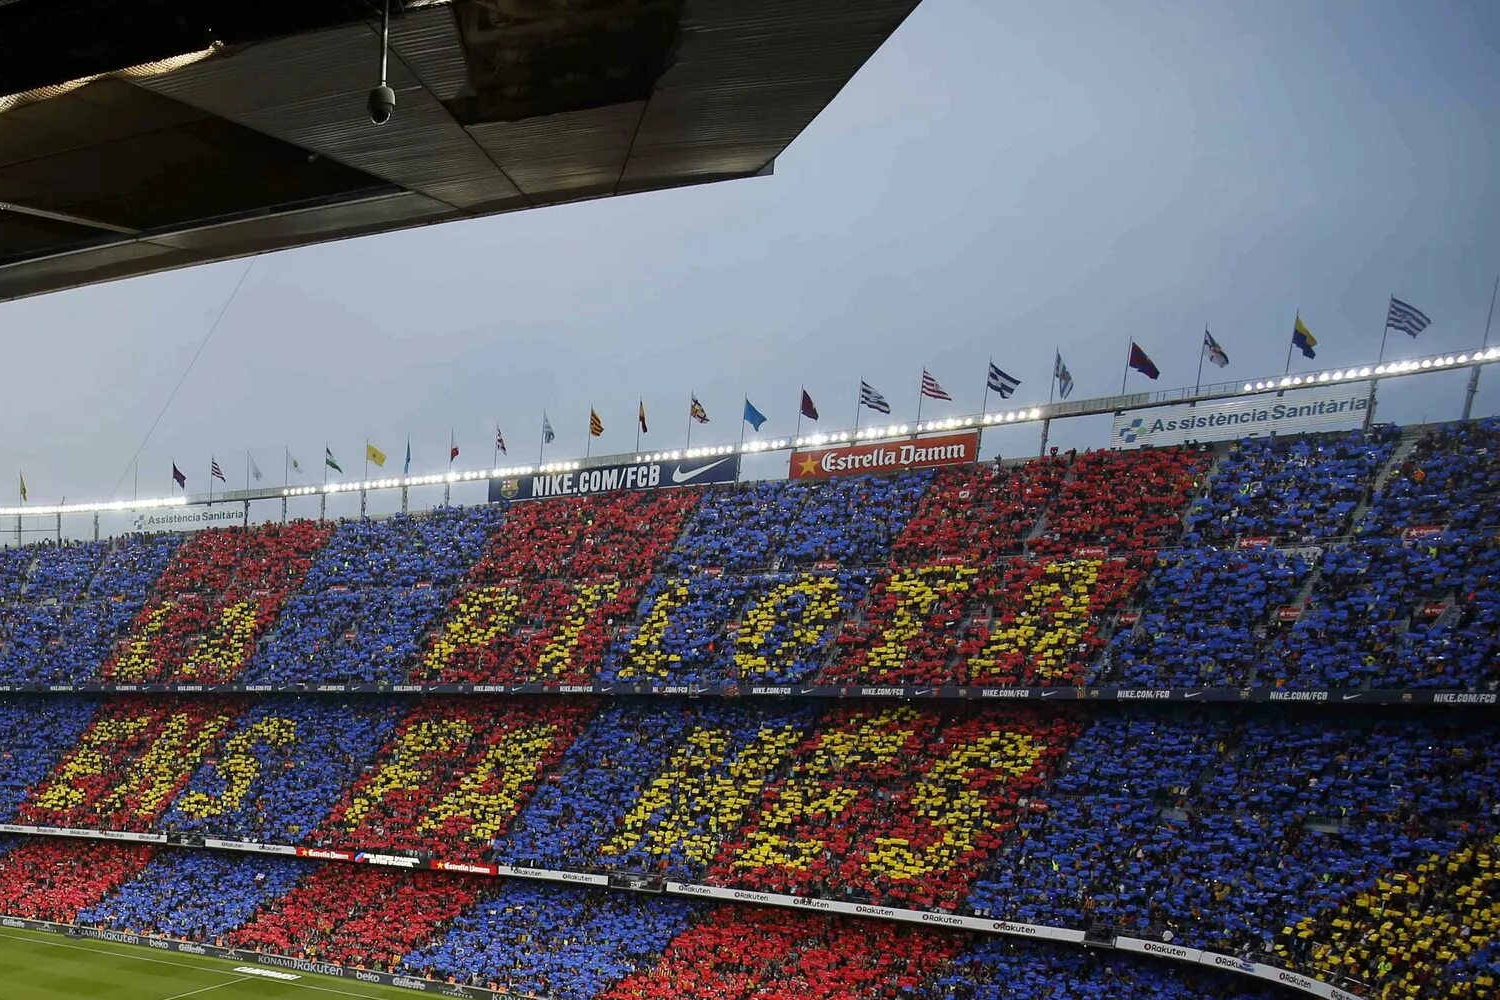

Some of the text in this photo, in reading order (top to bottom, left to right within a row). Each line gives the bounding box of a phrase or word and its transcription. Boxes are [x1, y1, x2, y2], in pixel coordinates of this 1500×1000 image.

[1150, 396, 1367, 433] Assistència Sanitària
[821, 443, 965, 472] Estrella Damm
[532, 464, 661, 497] NIKE.COM/FCB
[148, 510, 243, 525] Assistència Sanitària
[861, 688, 904, 696] NIKE.COM/FCB
[982, 689, 1030, 698] NIKE.COM/FCB
[1116, 690, 1170, 699] NIKE.COM/FCB
[1269, 691, 1328, 701] NIKE.COM/FCB
[1433, 693, 1497, 703] NIKE.COM/FCB
[518, 869, 542, 877] Rakuten
[567, 874, 592, 882] Rakuten
[684, 885, 711, 894] Rakuten
[740, 892, 769, 901] Rakuten
[799, 898, 829, 908] Rakuten
[862, 906, 894, 916] Rakuten
[3, 918, 25, 928] Gillette
[929, 914, 963, 925] Rakuten
[1000, 923, 1036, 934] Rakuten
[101, 929, 139, 944] Rakuten
[149, 939, 168, 949] beko
[178, 943, 205, 955] Gillette
[1151, 944, 1186, 957] Rakuten
[258, 955, 293, 969] KONAMI
[296, 958, 343, 976] Rakuten
[356, 971, 380, 983] beko
[1285, 974, 1312, 989] Rakuten
[392, 977, 425, 991] Gillette
